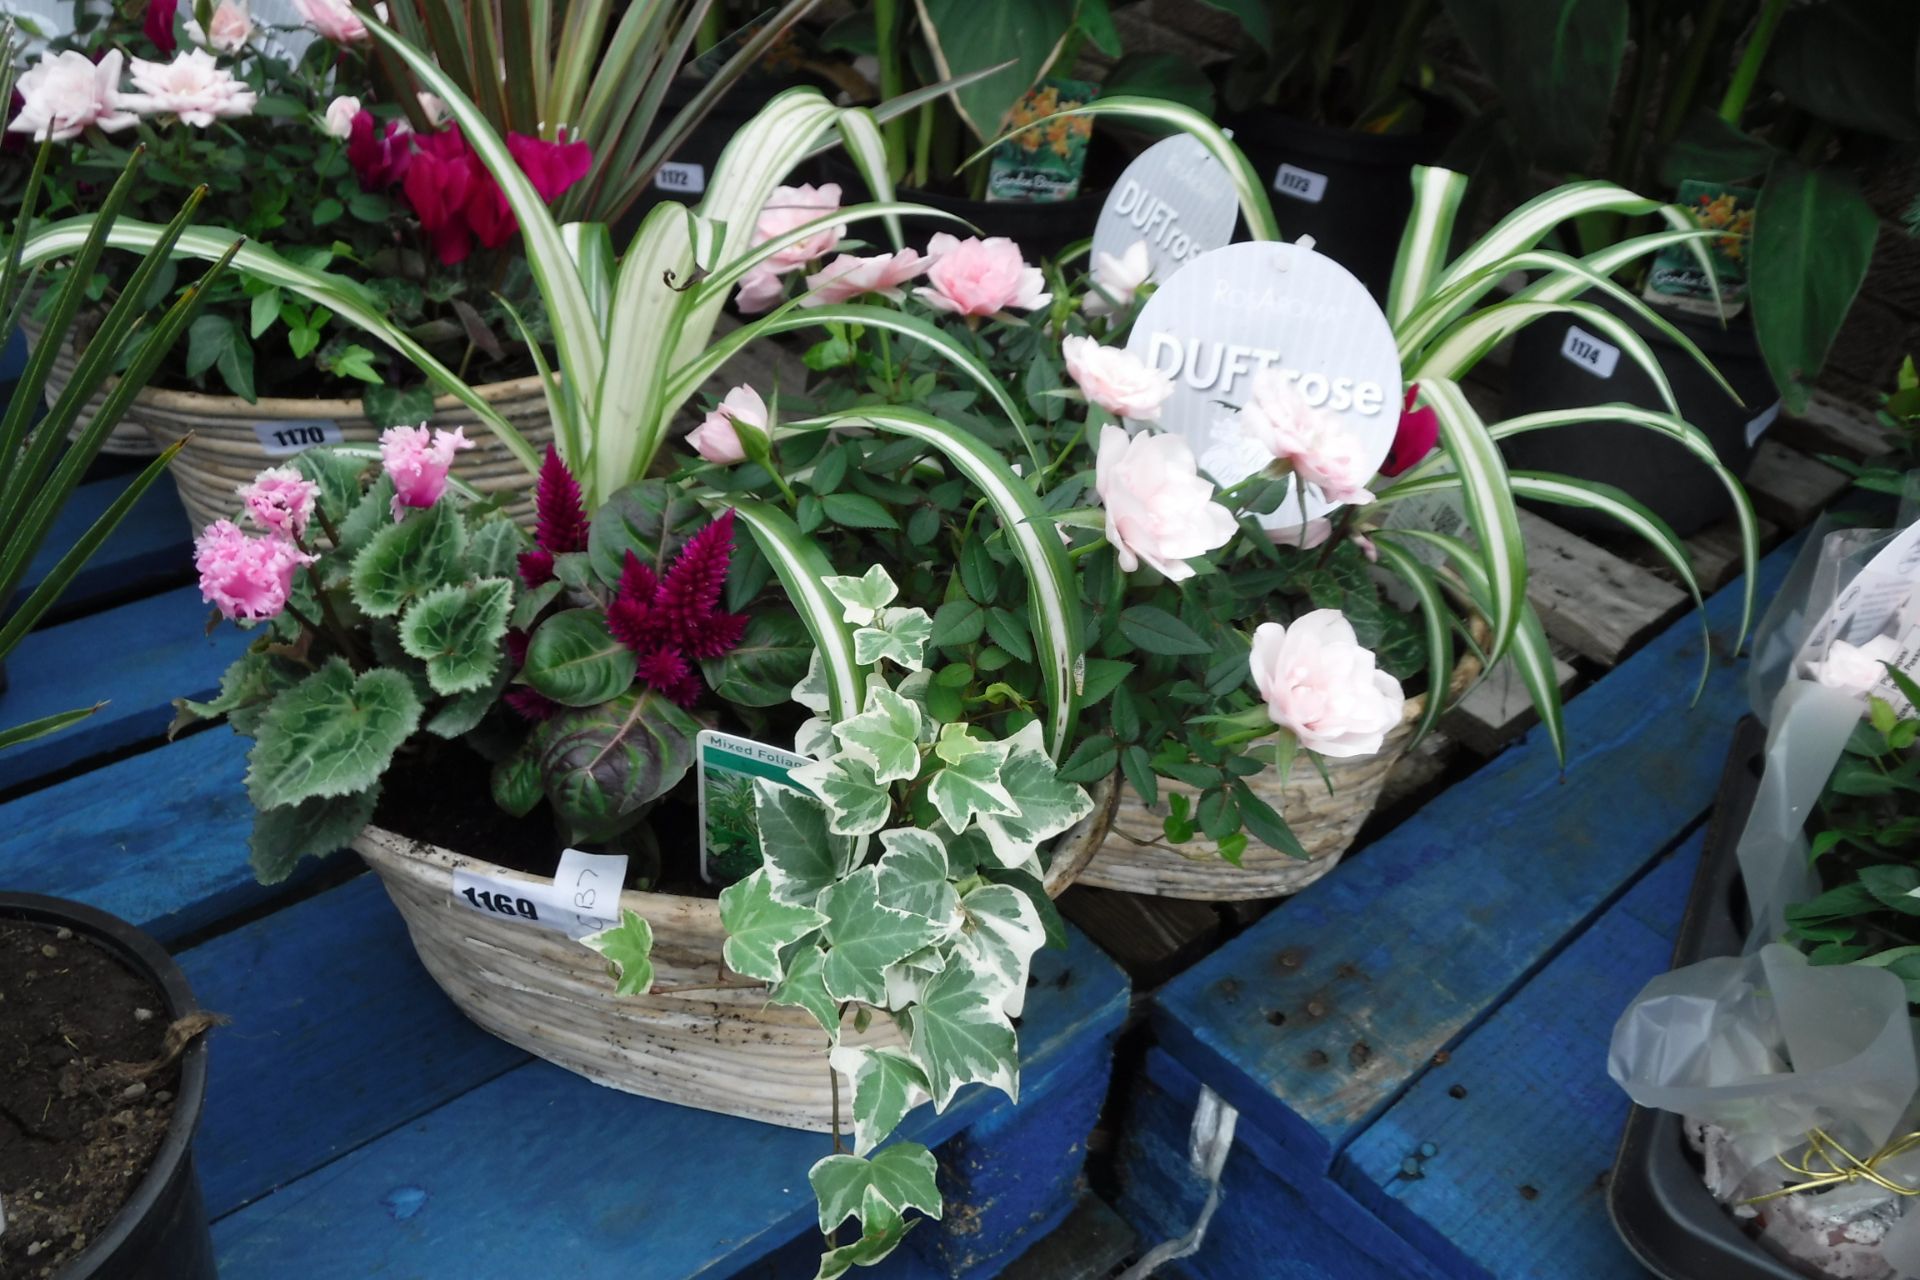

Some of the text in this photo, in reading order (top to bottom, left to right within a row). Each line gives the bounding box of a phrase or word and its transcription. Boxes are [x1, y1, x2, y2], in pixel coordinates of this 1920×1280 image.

[661, 169, 689, 187] 1172
[1570, 337, 1601, 365] 1174
[272, 426, 326, 447] 1170
[710, 735, 805, 768] Mixed Foliag
[462, 887, 539, 921] 1169
